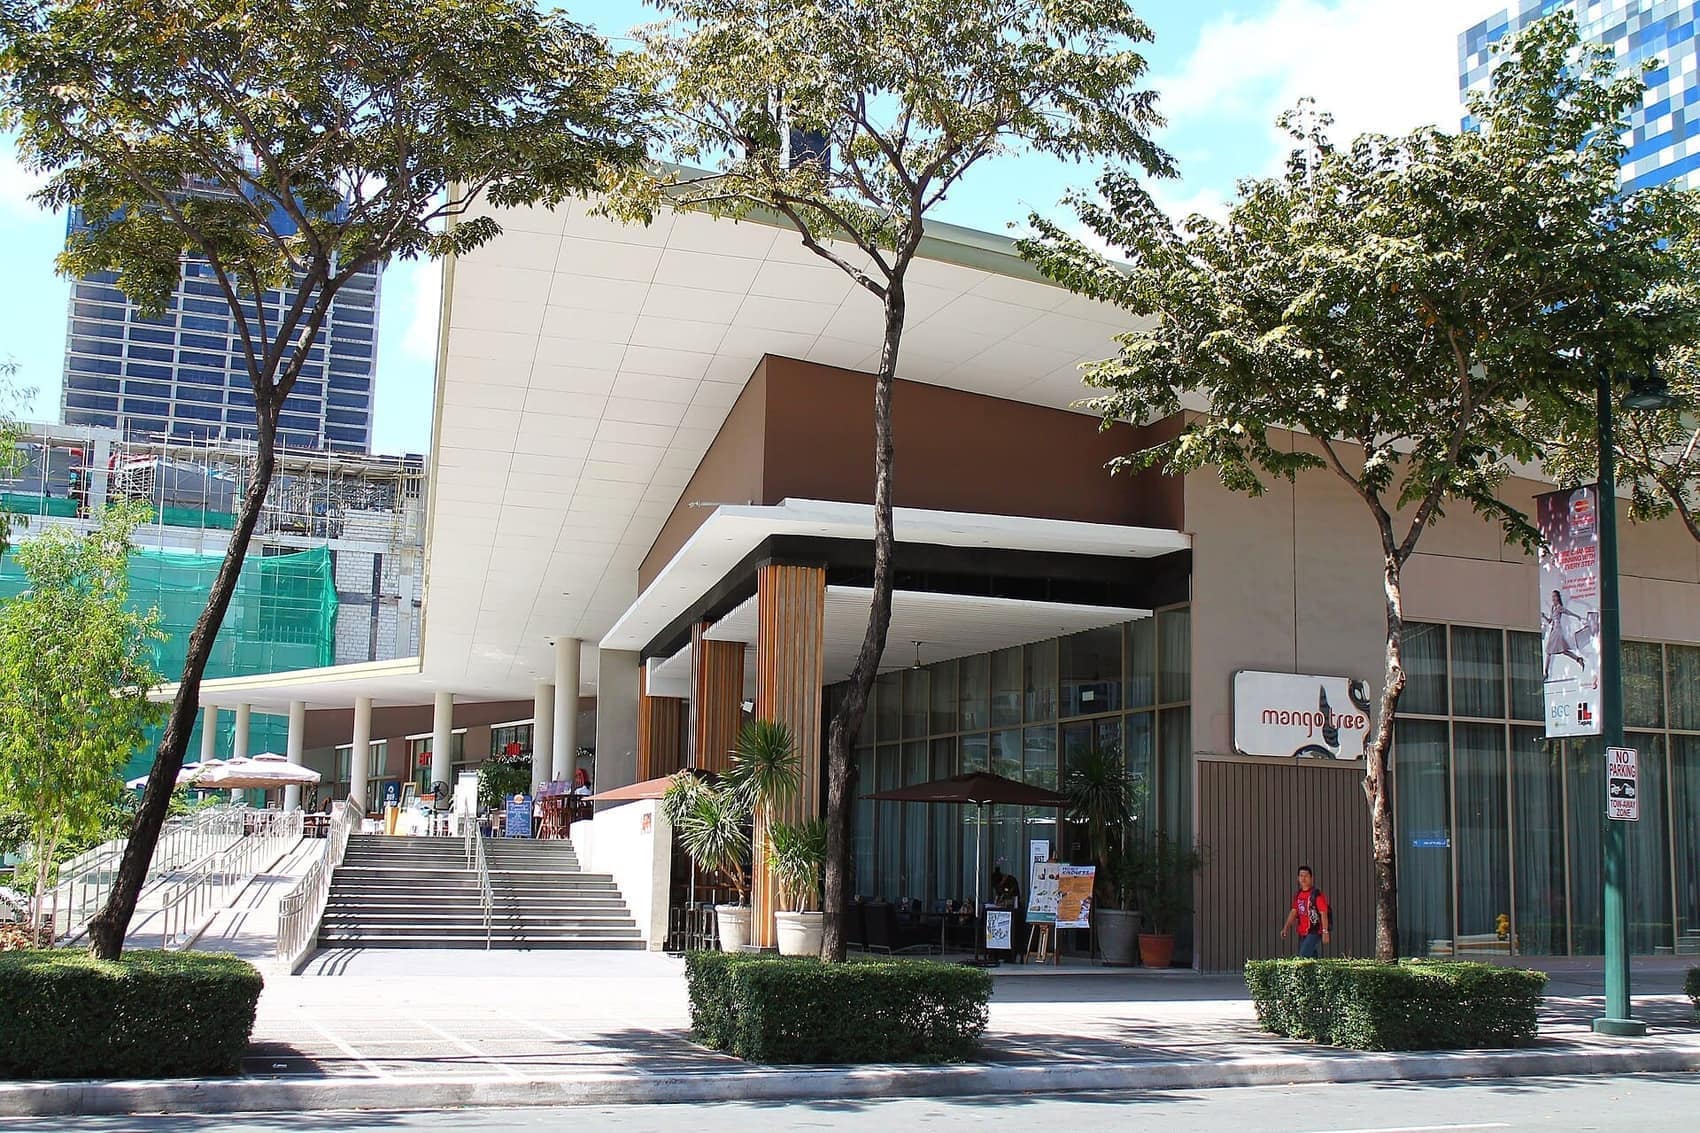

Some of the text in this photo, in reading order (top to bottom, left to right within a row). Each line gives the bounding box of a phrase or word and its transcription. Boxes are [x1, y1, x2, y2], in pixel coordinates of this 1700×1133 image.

[1551, 704, 1570, 719] BGC
[1262, 707, 1366, 738] mango tree
[1616, 751, 1629, 764] NO
[1609, 763, 1635, 778] PARKING
[1610, 799, 1636, 809] TOW-AWAY
[1616, 808, 1631, 817] ZONE
